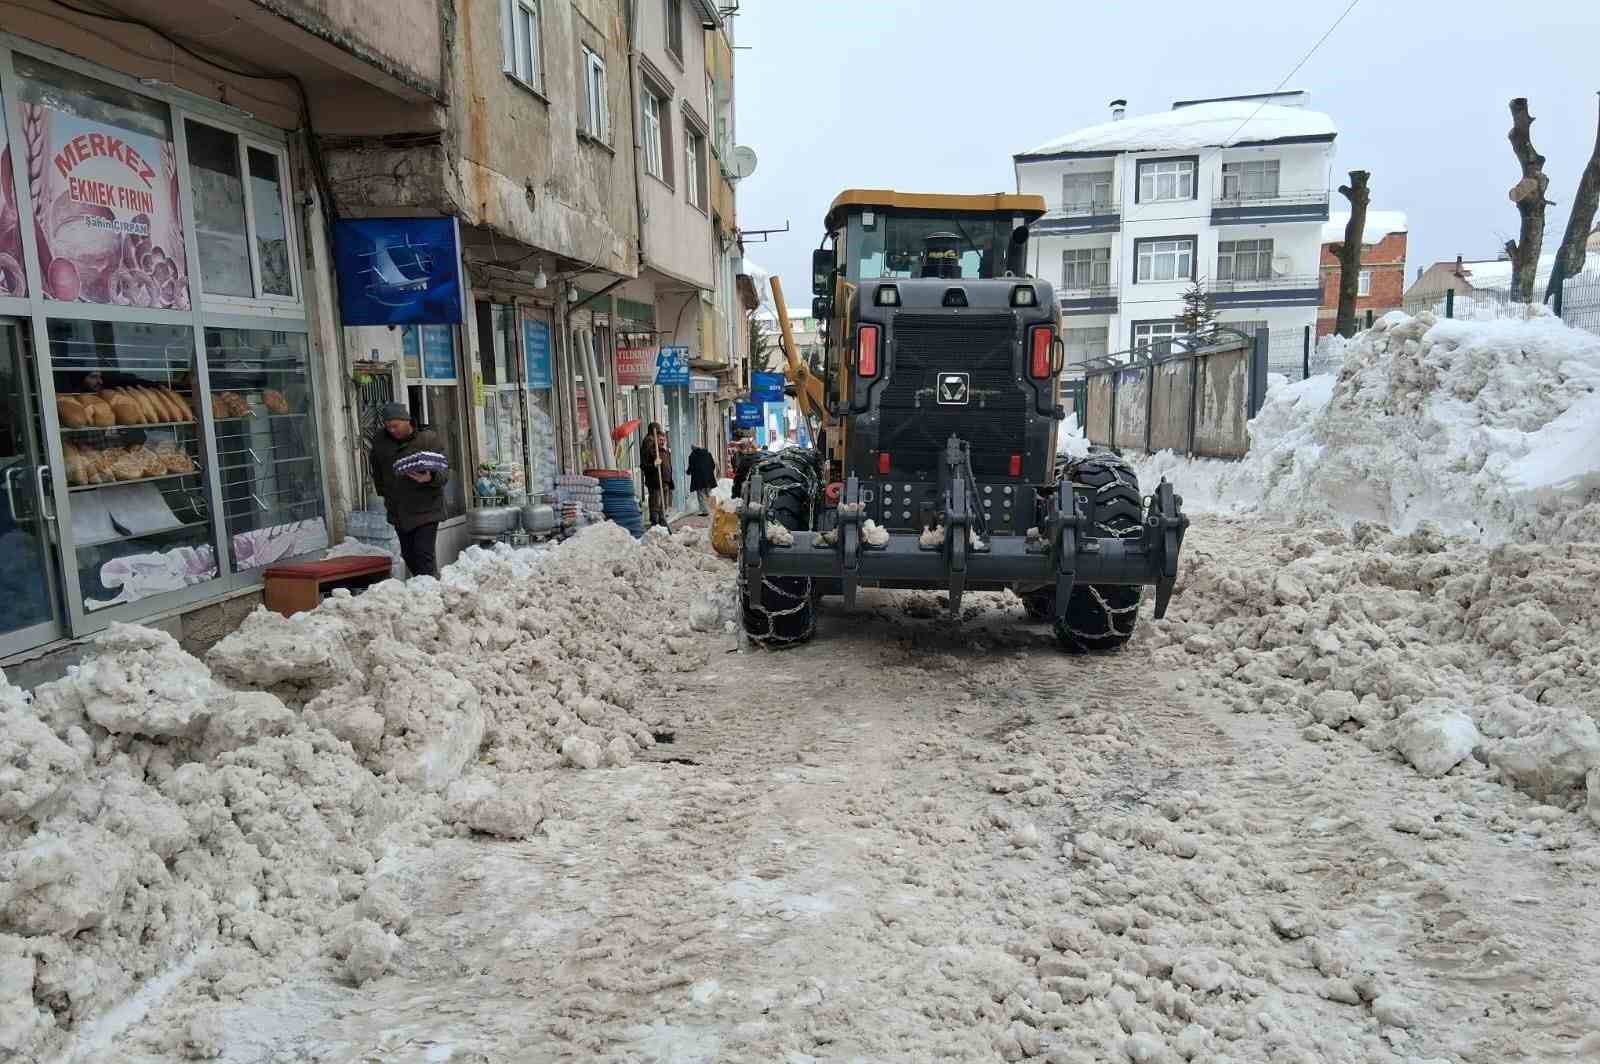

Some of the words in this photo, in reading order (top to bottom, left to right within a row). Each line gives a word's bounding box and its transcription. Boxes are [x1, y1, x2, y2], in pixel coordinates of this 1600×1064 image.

[54, 133, 156, 189] MERKEZ
[69, 176, 116, 207] EKMEK
[117, 186, 154, 214] FIRINI
